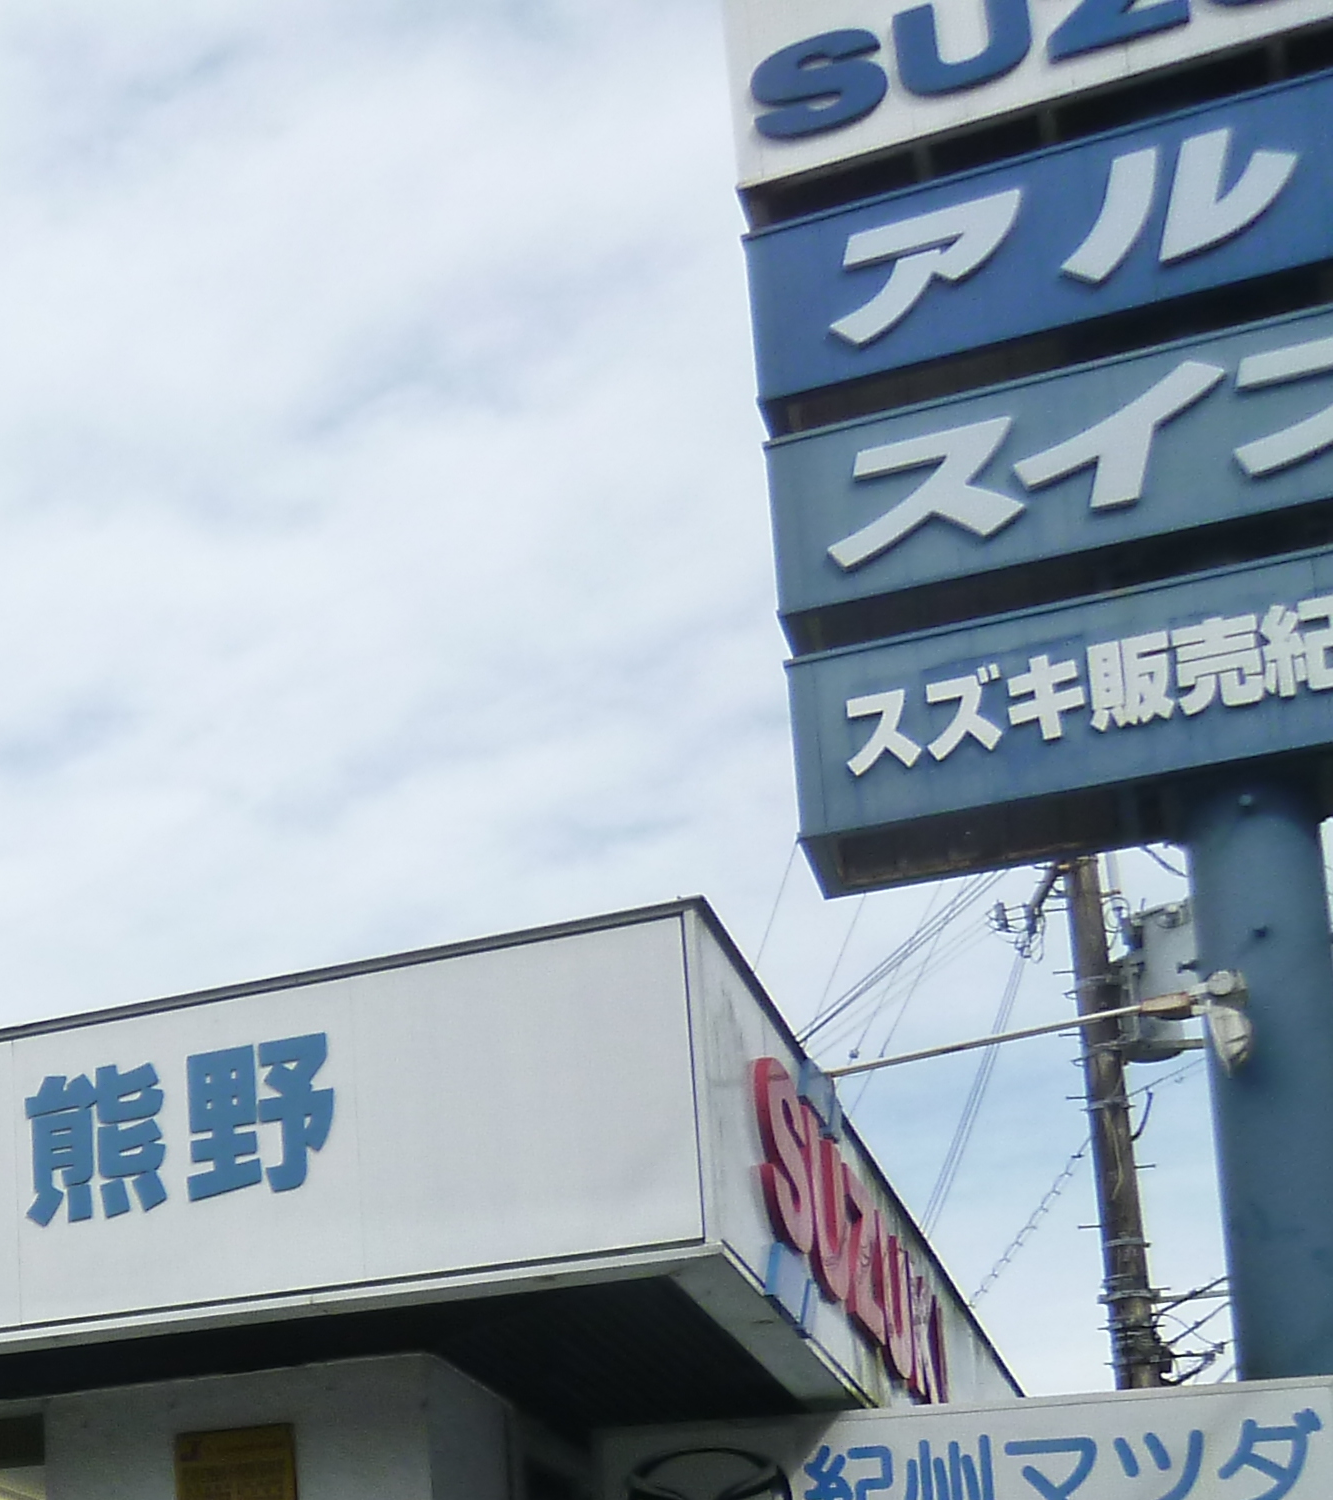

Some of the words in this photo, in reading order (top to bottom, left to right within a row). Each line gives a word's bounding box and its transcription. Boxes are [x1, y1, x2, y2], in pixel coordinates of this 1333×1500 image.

[749, 0, 1285, 140] SU
[829, 128, 1299, 347] アル
[845, 595, 1333, 778] スズキ販売紀
[24, 1031, 334, 1227] 熊野
[751, 1056, 949, 1404] SUZUKI
